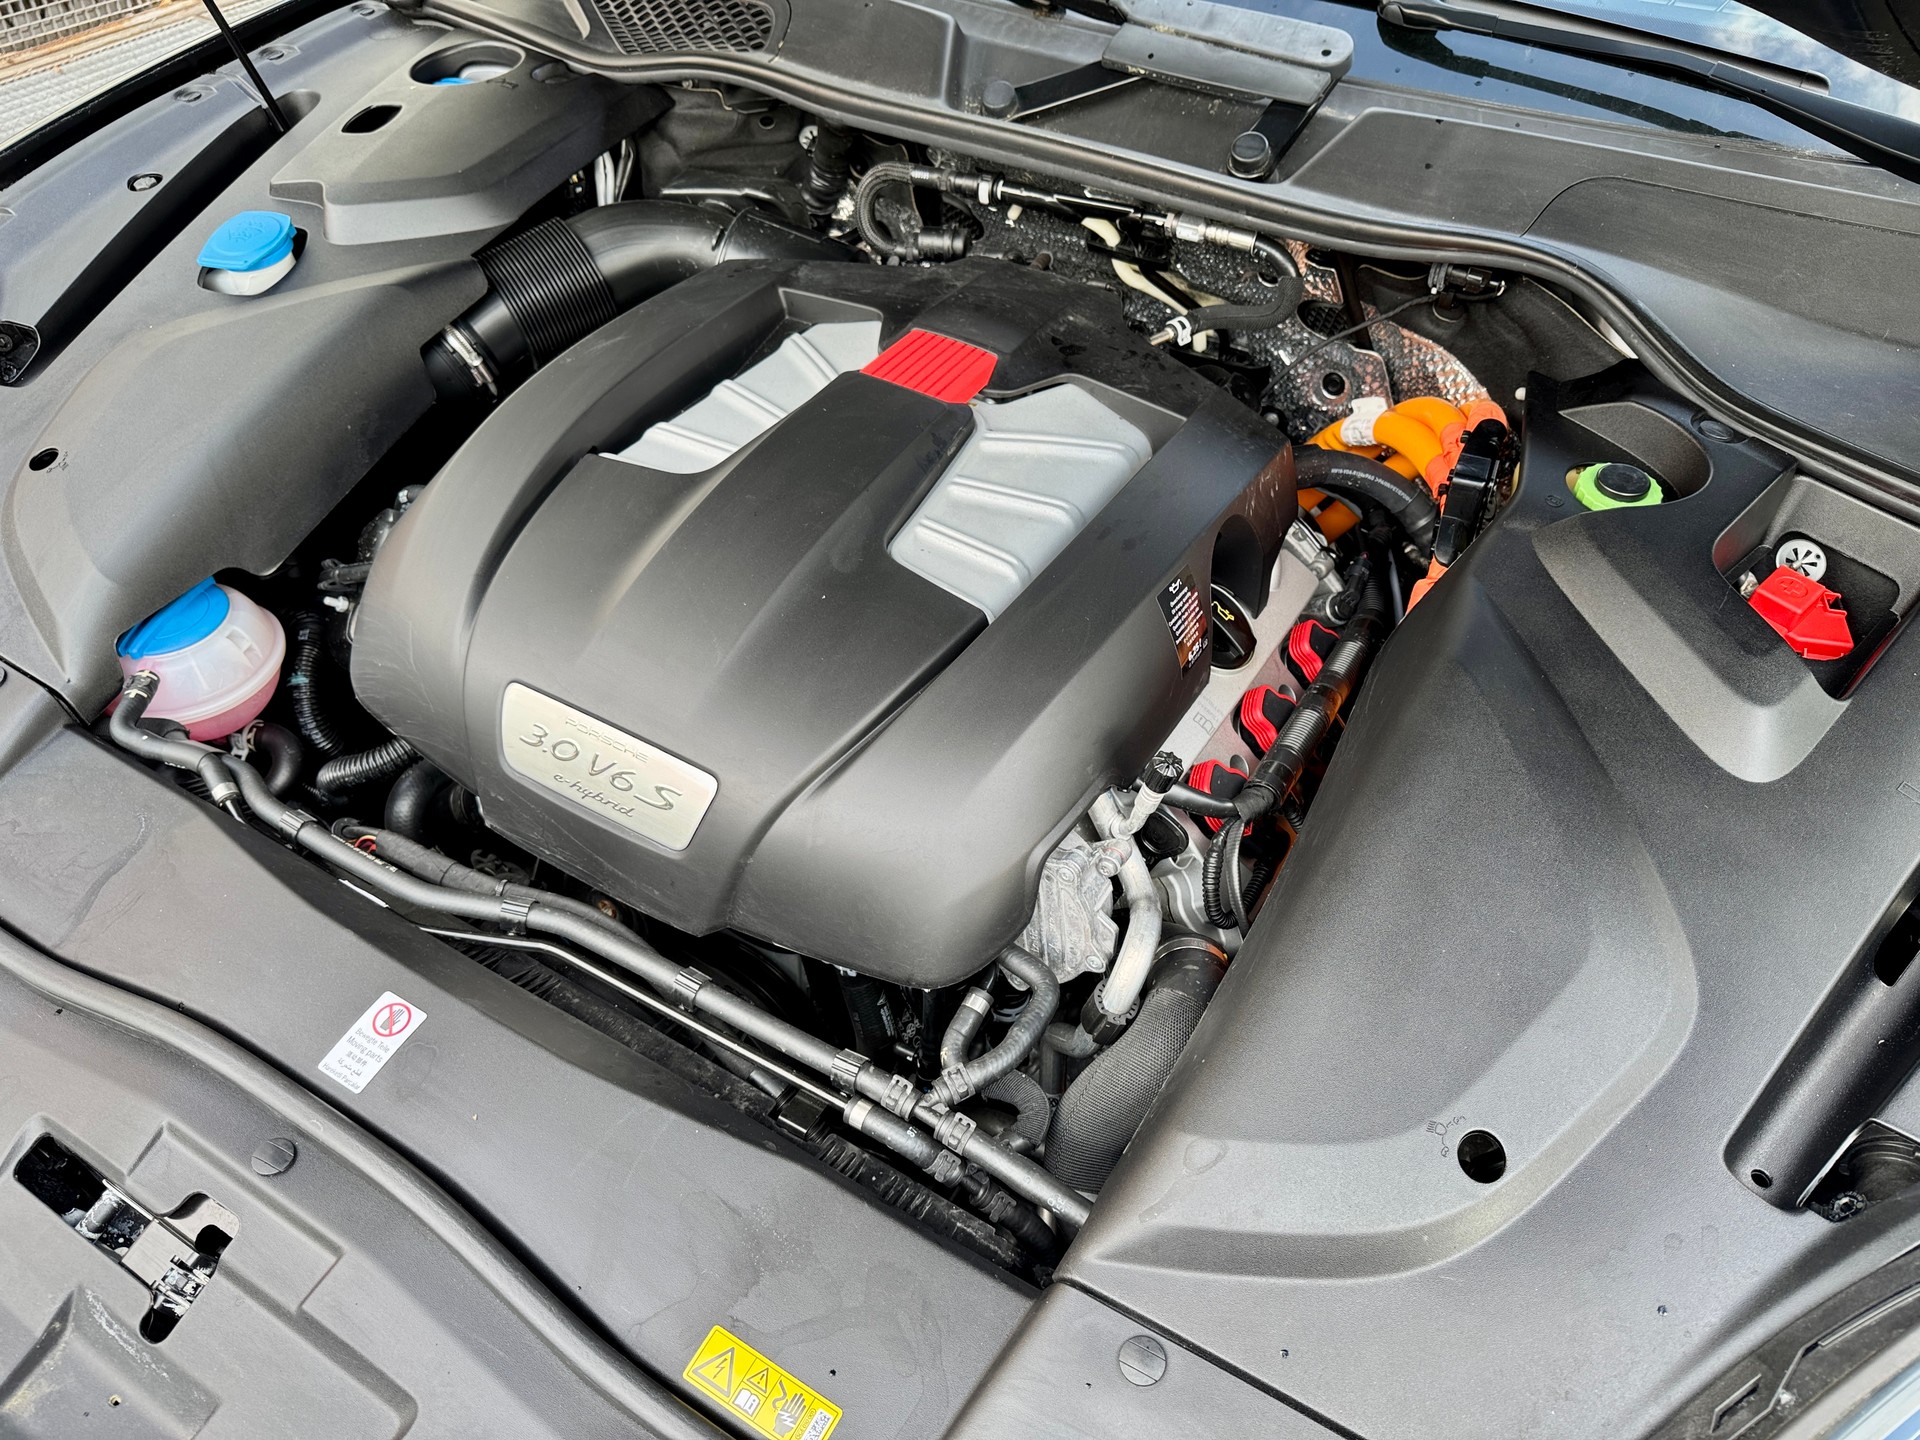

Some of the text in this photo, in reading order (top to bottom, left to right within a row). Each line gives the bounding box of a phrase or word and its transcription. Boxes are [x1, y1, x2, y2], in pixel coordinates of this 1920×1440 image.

[565, 718, 649, 764] PORSCHE
[519, 724, 684, 811] 3.0 V6 S
[553, 773, 634, 818] e-hybrid
[346, 1036, 383, 1063] Moving parts
[355, 1028, 390, 1053] Bewegte Teile
